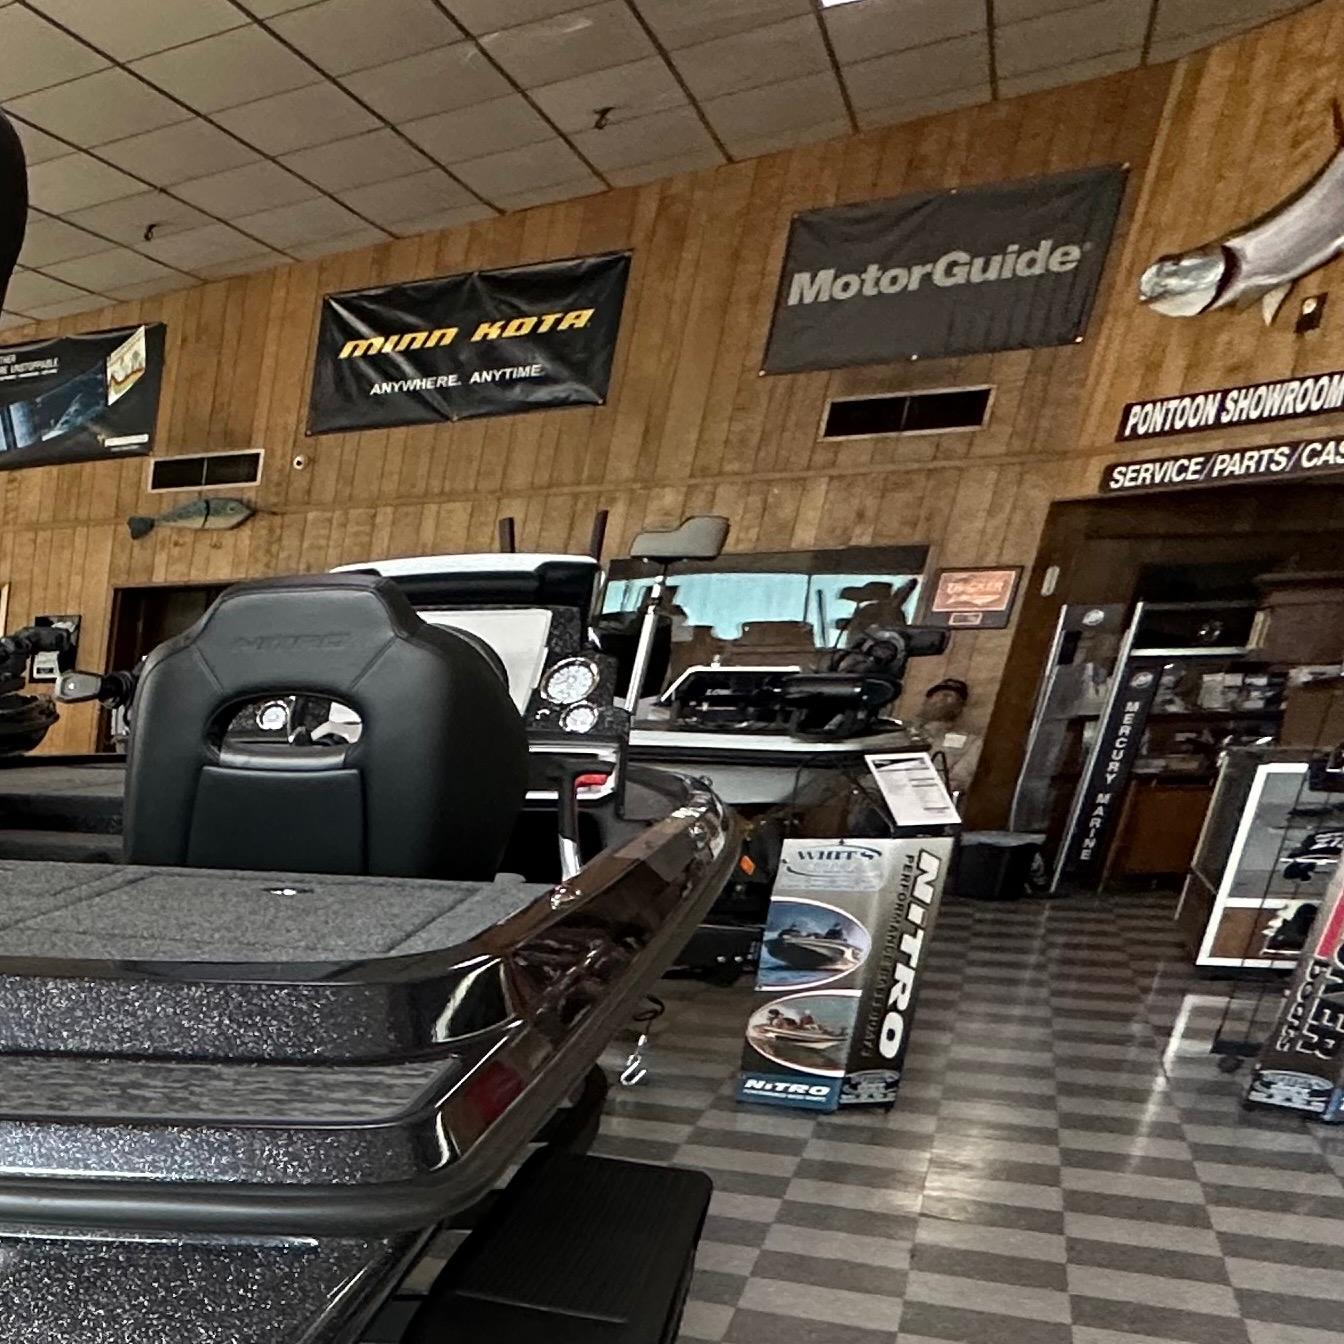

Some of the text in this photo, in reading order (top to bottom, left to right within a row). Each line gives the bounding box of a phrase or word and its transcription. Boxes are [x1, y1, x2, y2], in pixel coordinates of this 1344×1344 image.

[787, 239, 1082, 306] MotorGuide
[470, 308, 596, 342] KOTA
[369, 374, 462, 396] ANYWHERE.
[1124, 373, 1344, 437] PONTOON SHOWROOM
[1079, 701, 1141, 861] MERCURY MARINE
[880, 855, 918, 962] PERFORMANCE
